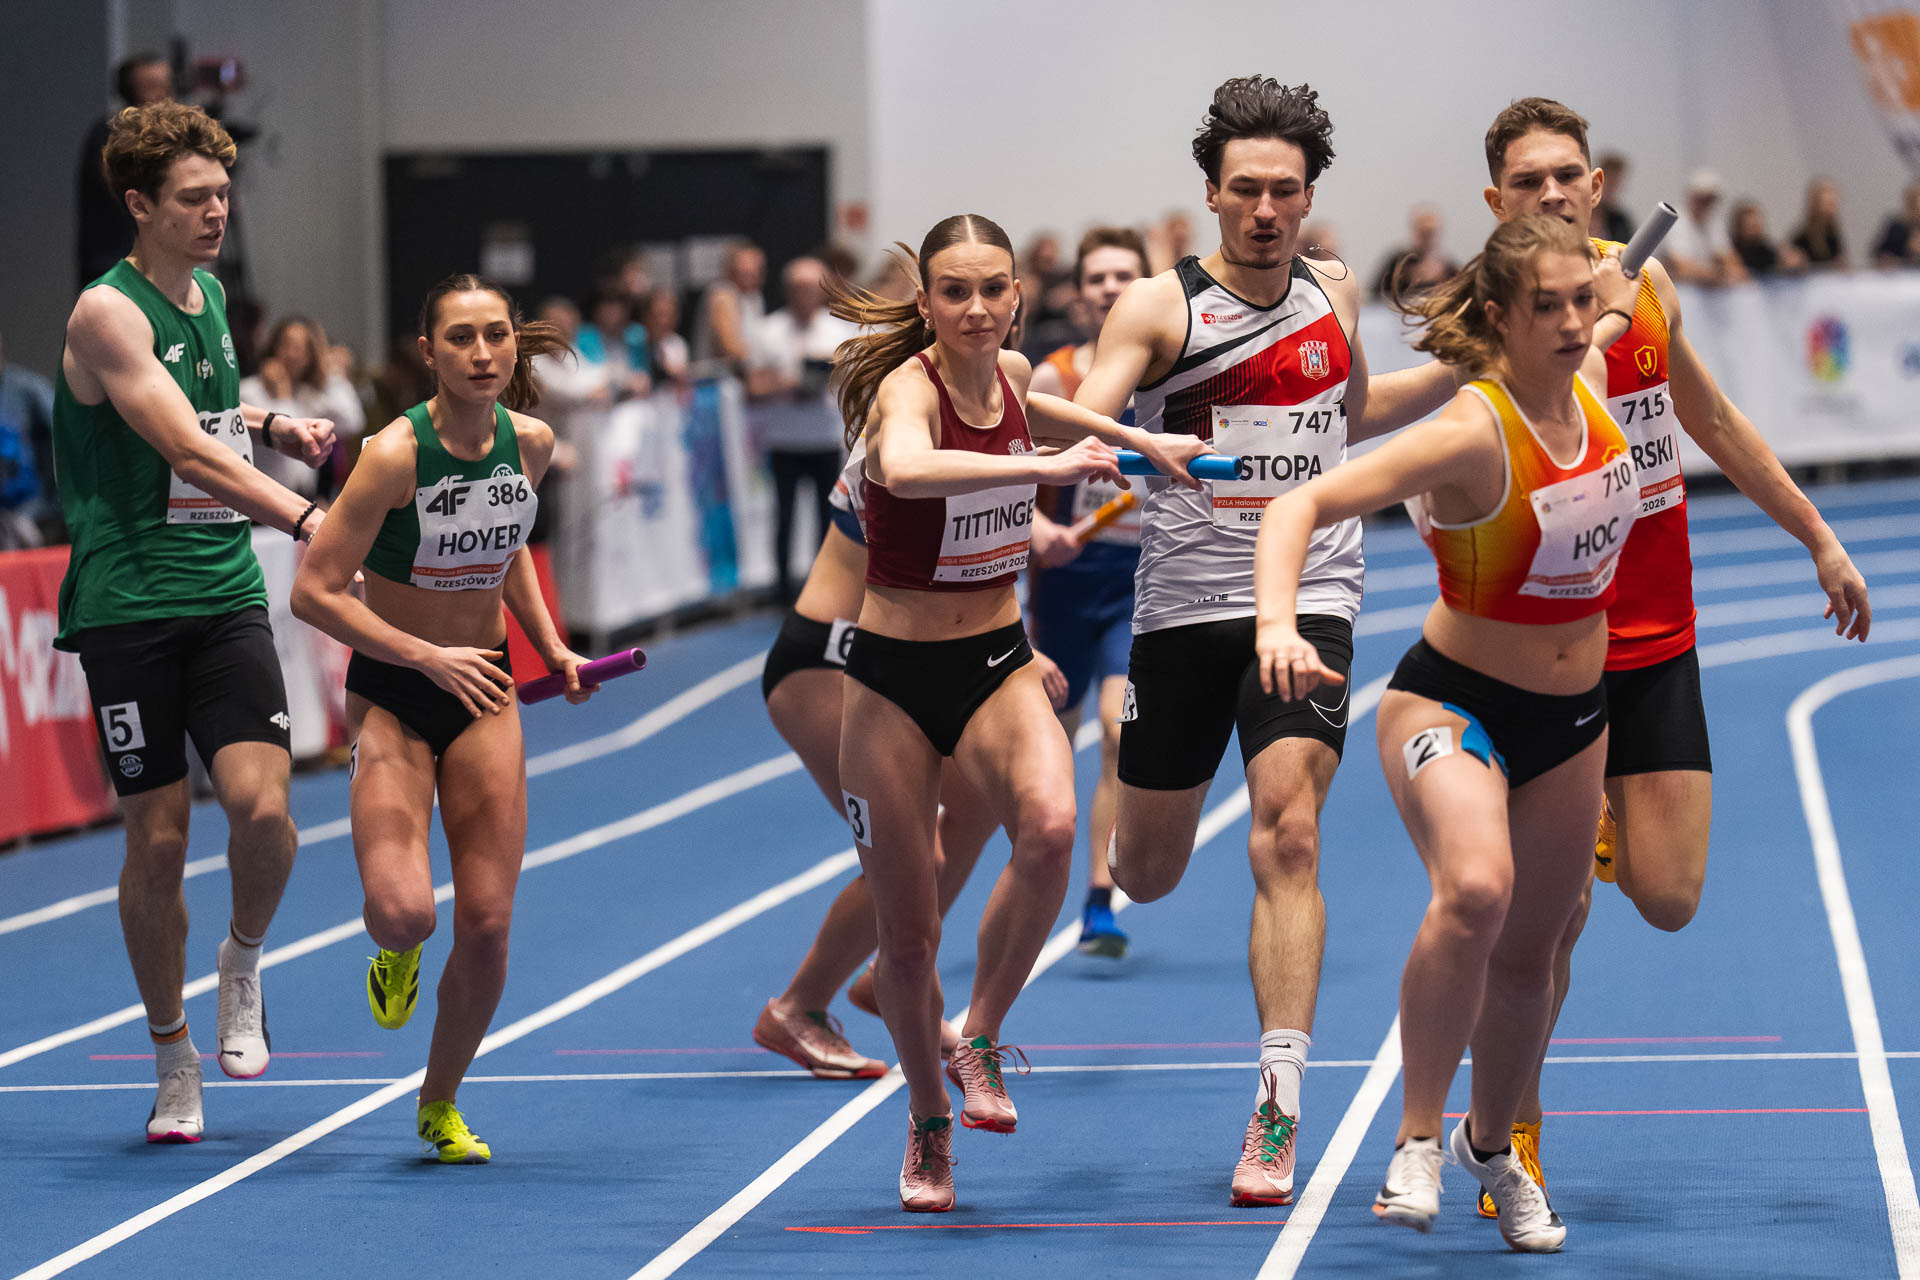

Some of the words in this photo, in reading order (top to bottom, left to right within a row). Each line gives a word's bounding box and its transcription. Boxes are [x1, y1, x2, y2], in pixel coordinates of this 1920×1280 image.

[1643, 351, 1652, 370] J
[1288, 411, 1332, 434] 747
[1621, 392, 1665, 425] 715
[1240, 454, 1322, 481] STOPA
[1630, 434, 1673, 473] RSKI
[1602, 462, 1631, 498] 710
[425, 486, 471, 516] 4F
[487, 481, 528, 507] 386
[1642, 496, 1666, 512] 2026
[952, 498, 1035, 541] TITTINGE
[1240, 512, 1264, 521] RZE
[438, 524, 521, 556] HOYER
[1573, 516, 1619, 560] HOC
[434, 575, 488, 588] RZESZÓW
[961, 561, 1007, 577] RZESZÓW
[108, 707, 133, 747] 5
[1413, 733, 1439, 769] 2
[847, 797, 865, 840] 3
